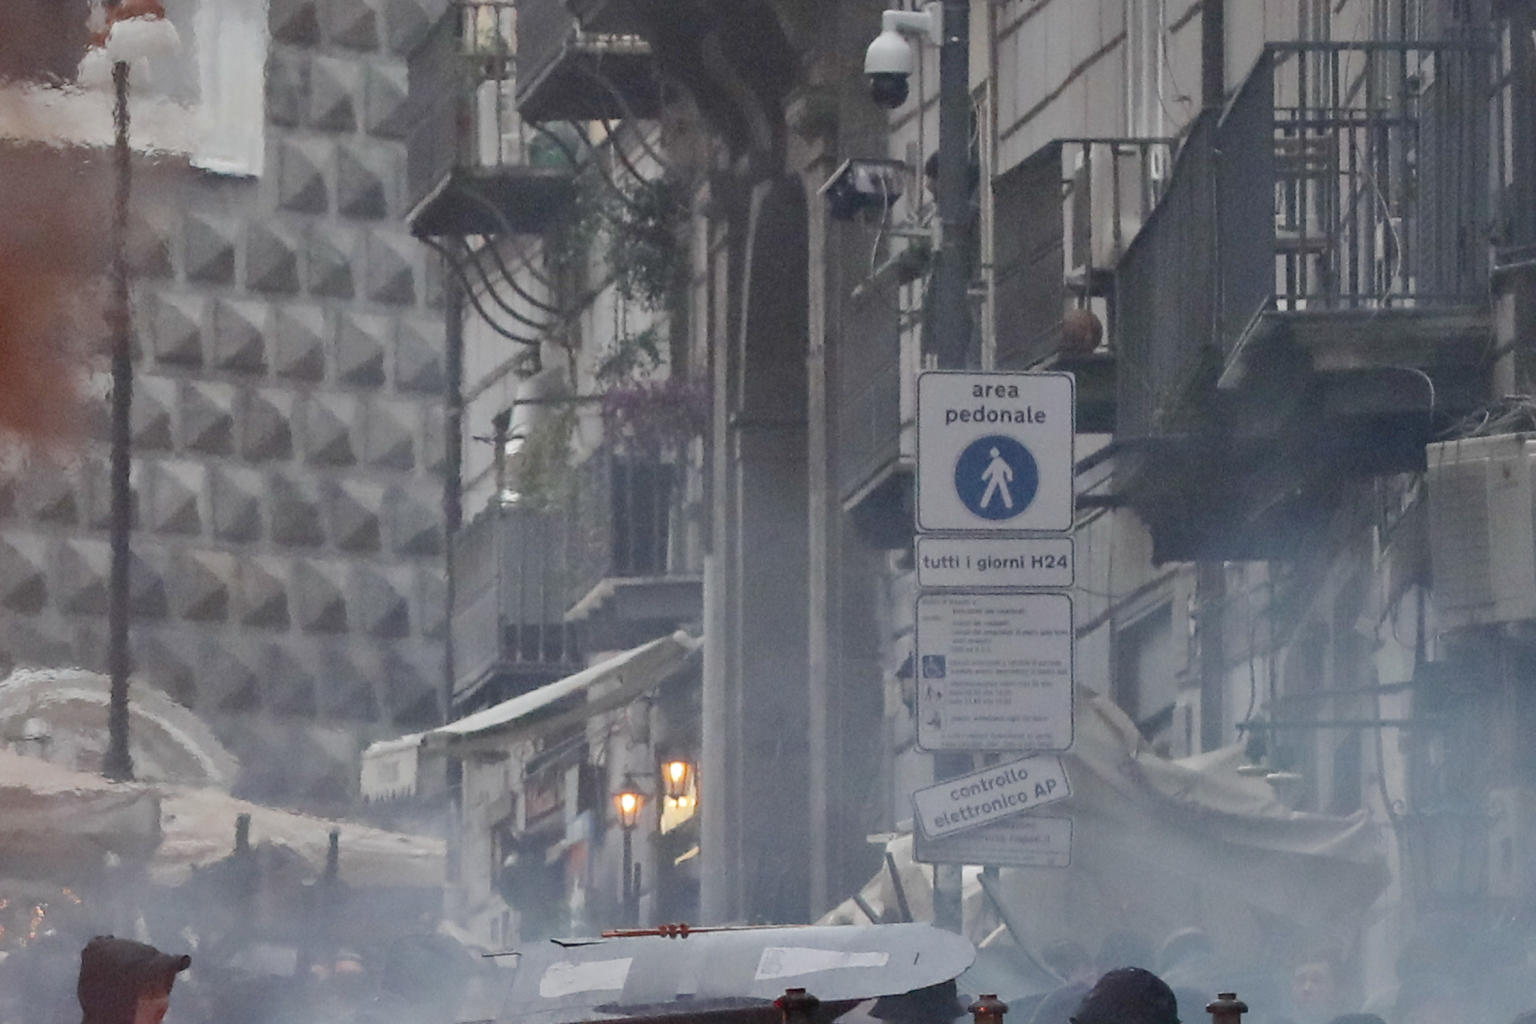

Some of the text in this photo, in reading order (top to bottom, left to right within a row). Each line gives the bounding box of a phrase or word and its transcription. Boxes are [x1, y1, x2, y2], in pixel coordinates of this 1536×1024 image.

[972, 382, 1019, 399] area
[945, 406, 1046, 425] pedonale
[923, 555, 960, 569] tutti
[977, 555, 1025, 572] giorni
[1031, 555, 1069, 569] H24
[950, 768, 1029, 801] controllo
[934, 778, 1058, 828] elettronico AP
